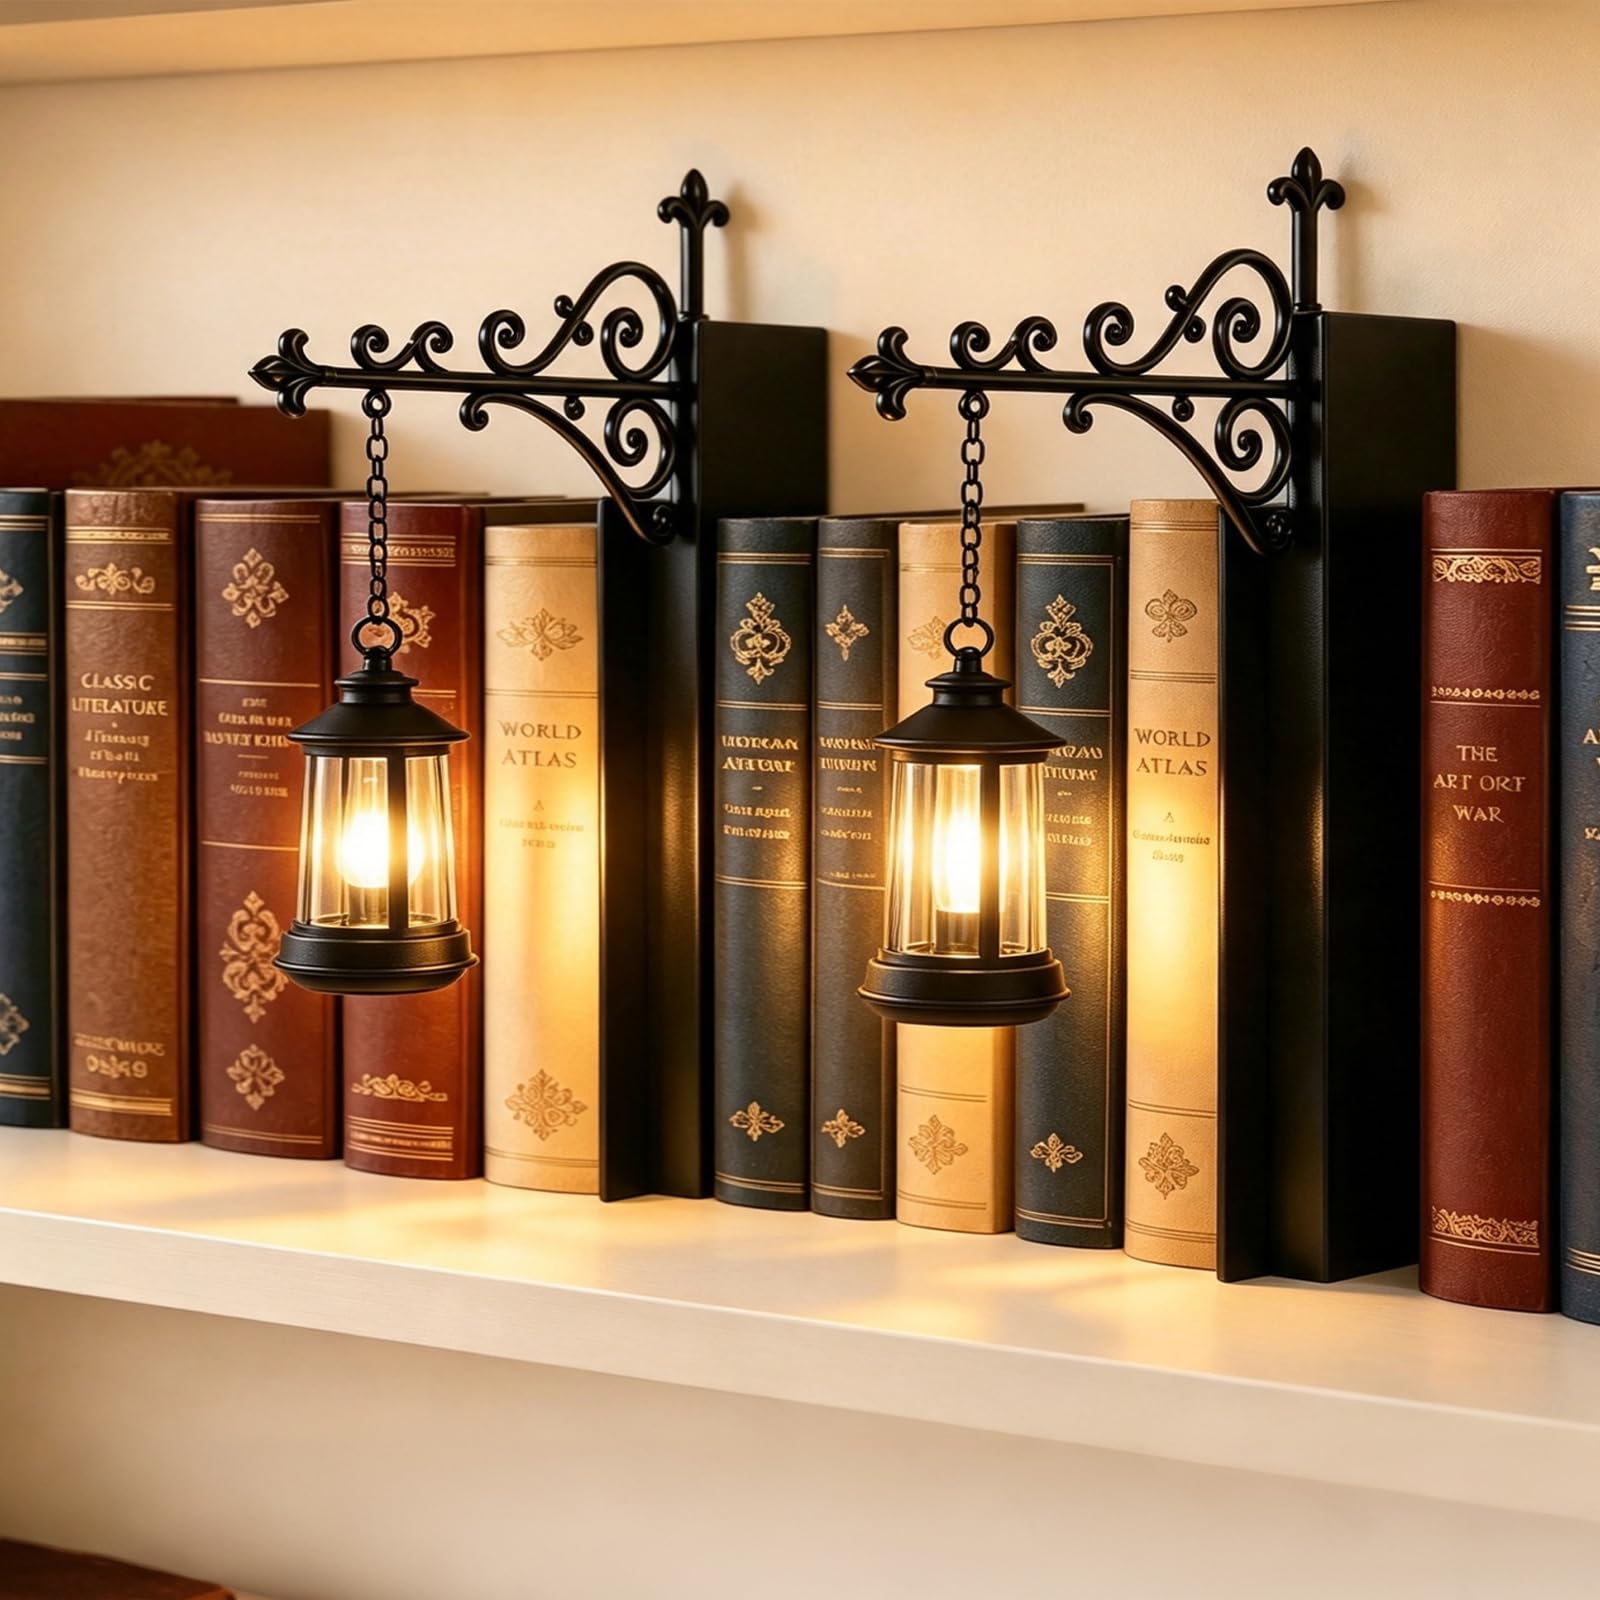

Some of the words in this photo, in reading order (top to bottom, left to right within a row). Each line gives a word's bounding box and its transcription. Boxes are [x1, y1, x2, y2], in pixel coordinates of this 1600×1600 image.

[81, 672, 155, 691] CLASSIC
[499, 720, 582, 740] WORLD
[1134, 728, 1211, 748] WORLD
[502, 749, 577, 768] ATLAS
[1456, 745, 1498, 762] THE
[1136, 757, 1208, 777] ATLAS
[1433, 774, 1472, 790] ART
[1452, 805, 1504, 823] WAR
